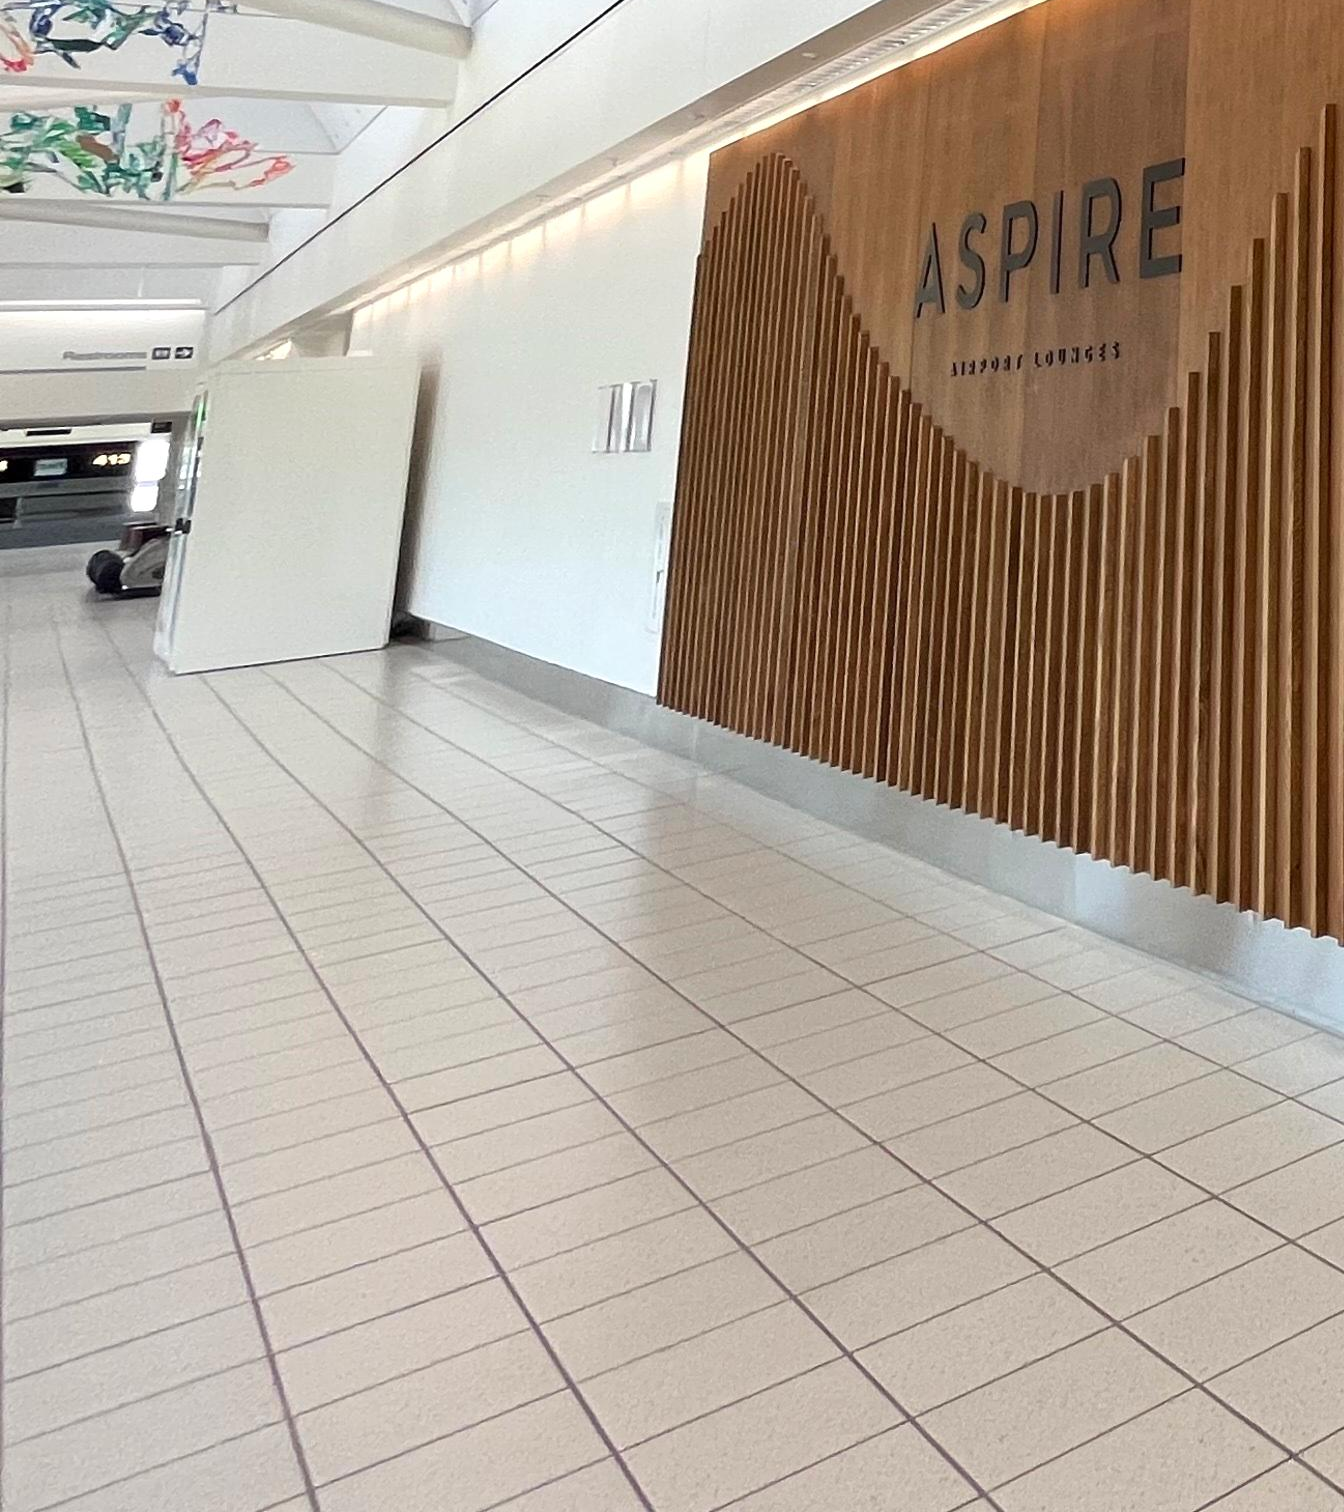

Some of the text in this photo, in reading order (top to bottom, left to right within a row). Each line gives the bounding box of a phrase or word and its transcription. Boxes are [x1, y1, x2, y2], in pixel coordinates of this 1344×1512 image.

[914, 157, 1186, 319] ASPIRE
[951, 340, 1120, 377] AIRPORT LOUNGES
